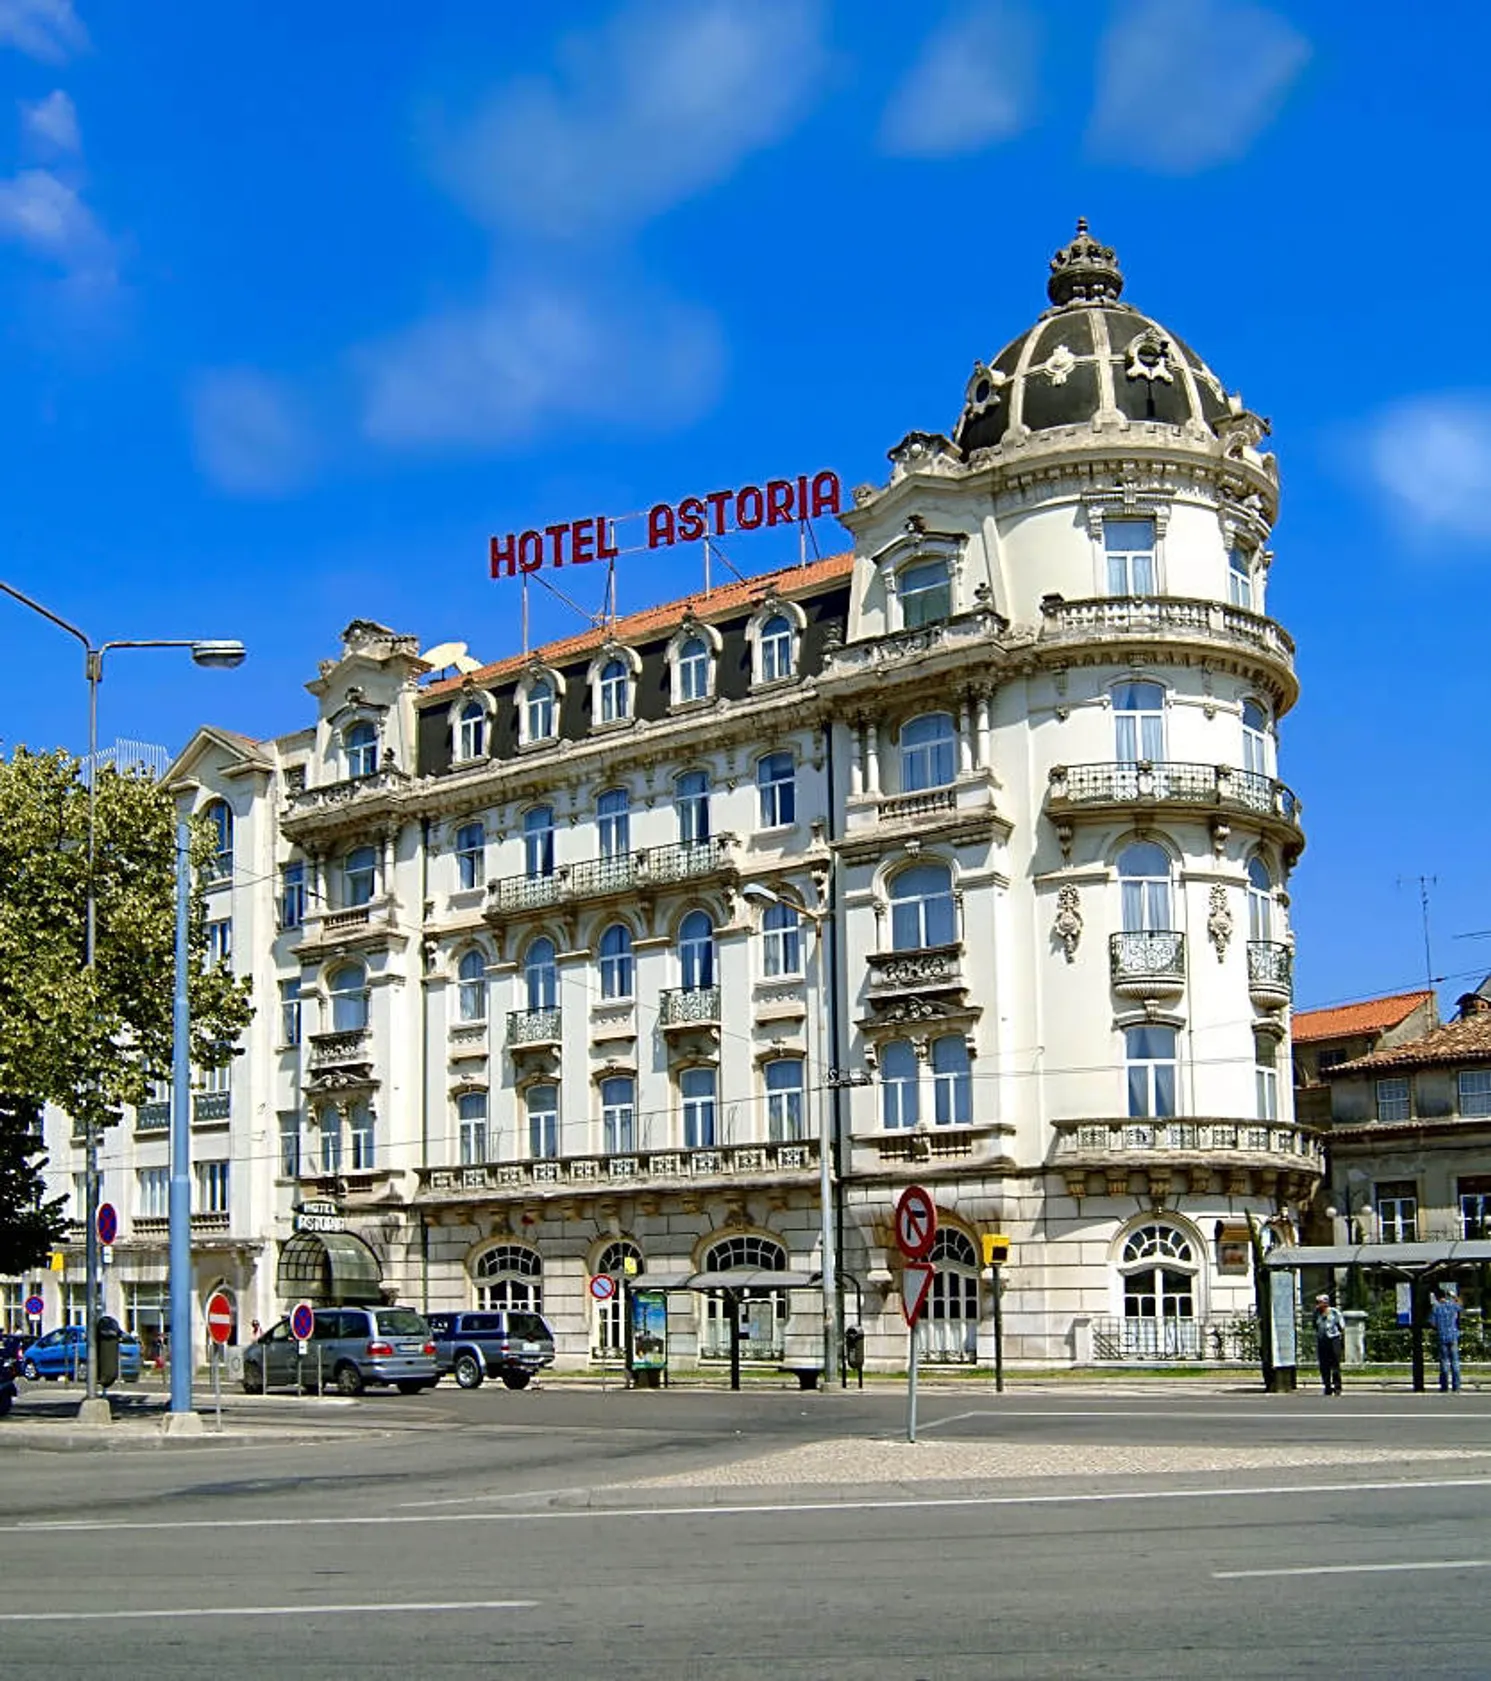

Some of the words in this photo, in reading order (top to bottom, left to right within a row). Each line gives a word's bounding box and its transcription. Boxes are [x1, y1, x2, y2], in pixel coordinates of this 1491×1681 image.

[490, 517, 619, 579] HOTEL
[649, 471, 841, 549] ASTORIA
[303, 1203, 336, 1214] HOTEL
